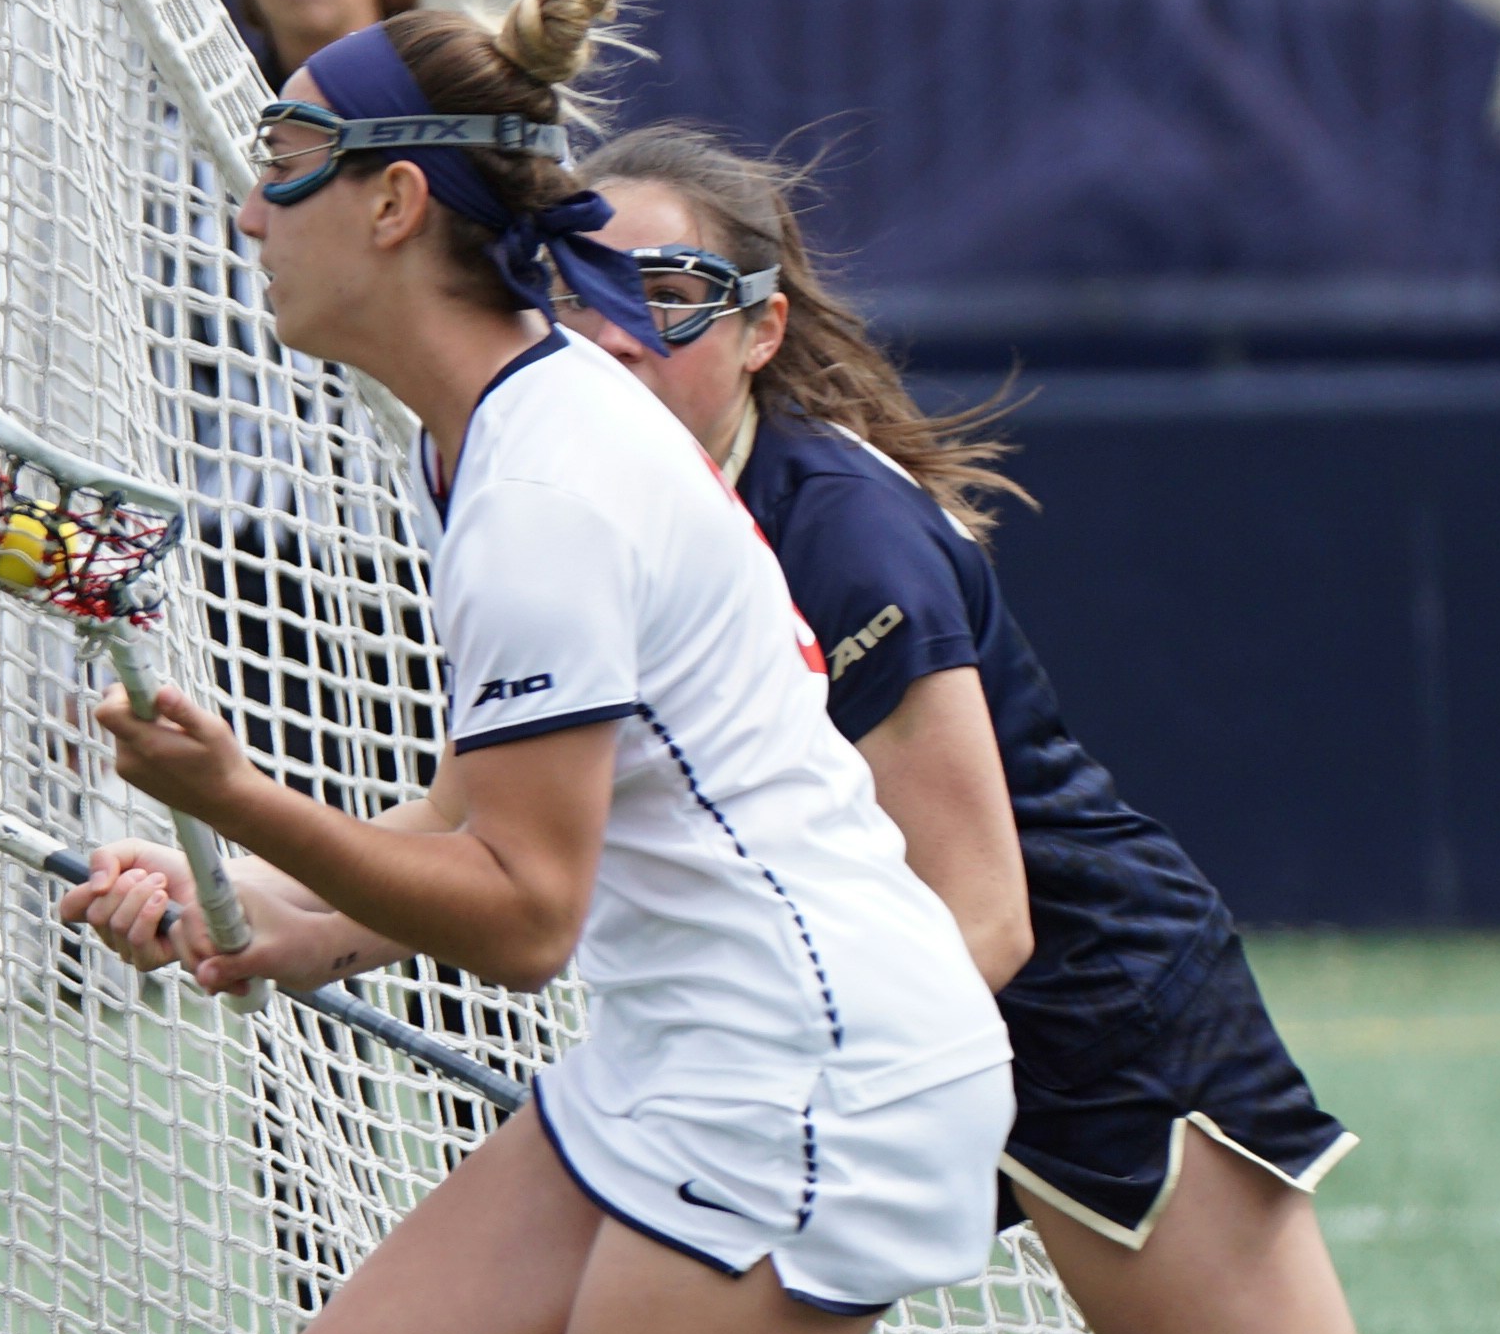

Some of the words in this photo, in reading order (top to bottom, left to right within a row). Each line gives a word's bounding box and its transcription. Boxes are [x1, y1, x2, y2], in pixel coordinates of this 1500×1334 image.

[369, 118, 470, 144] STX
[824, 604, 904, 682] A10
[472, 673, 554, 708] A10
